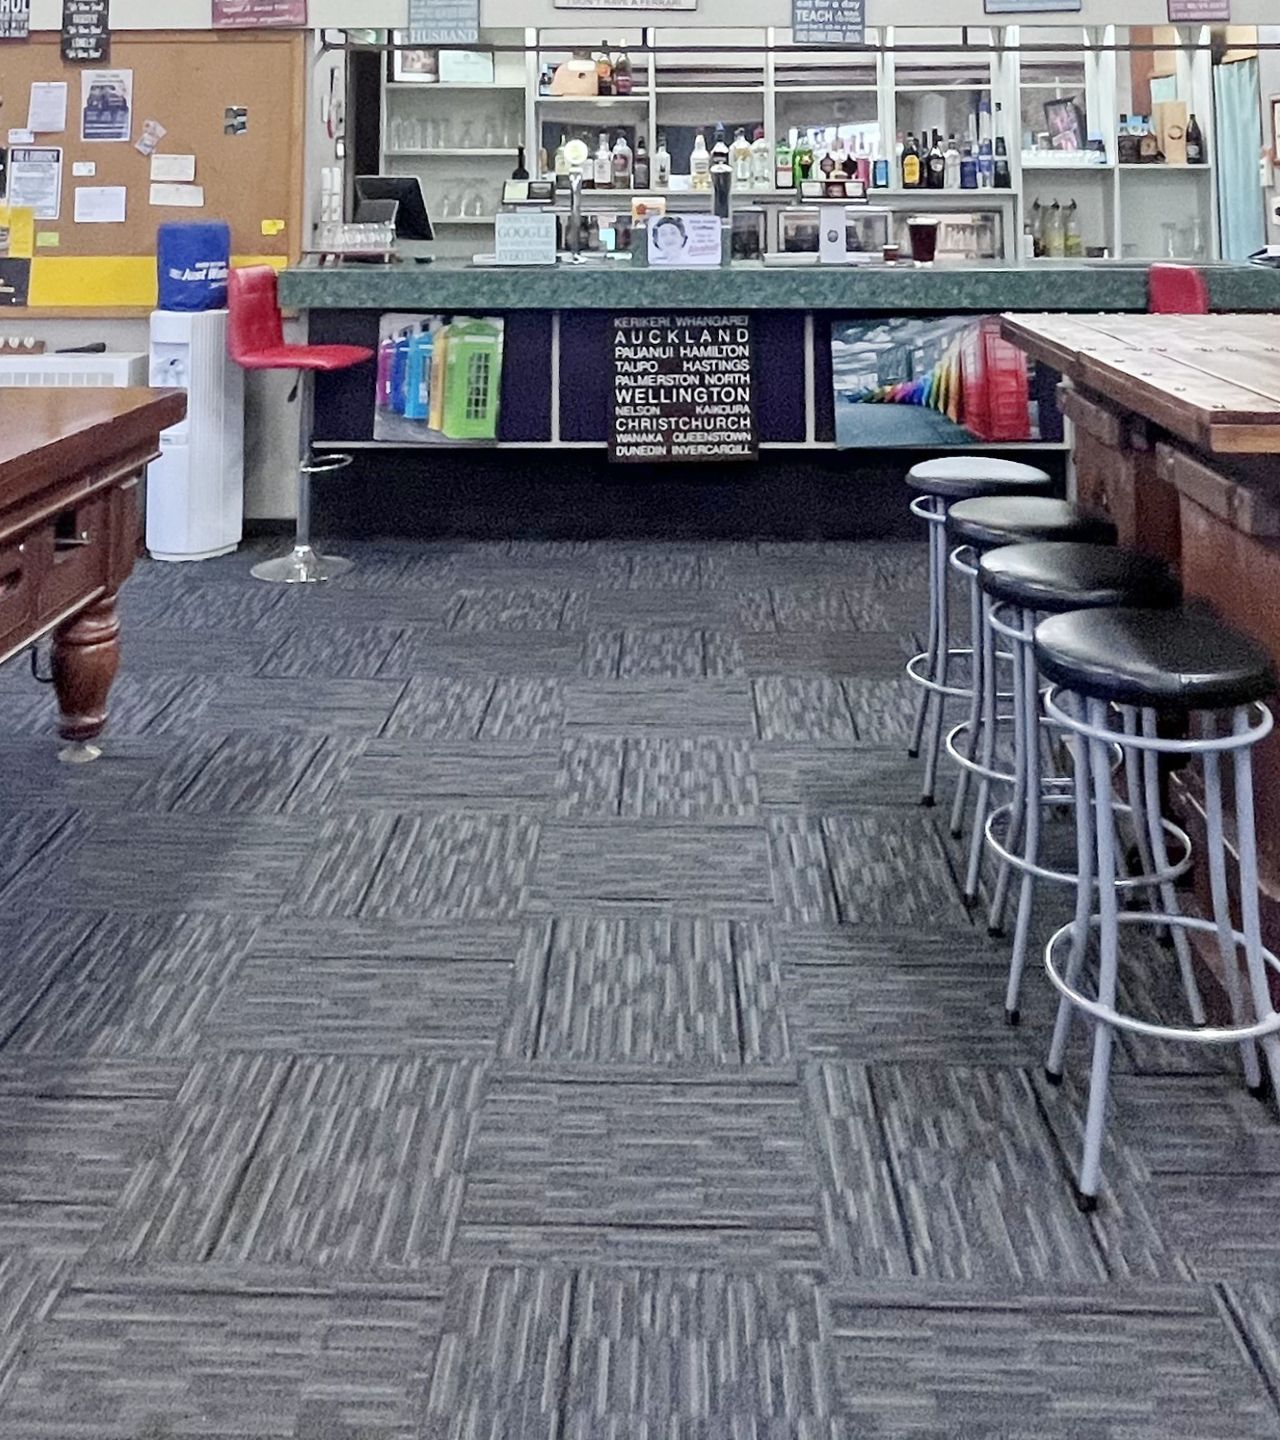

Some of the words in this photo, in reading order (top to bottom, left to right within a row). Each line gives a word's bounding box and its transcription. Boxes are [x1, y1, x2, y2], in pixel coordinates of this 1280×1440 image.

[796, 0, 812, 8] eat
[815, 0, 830, 8] for
[841, 0, 860, 10] day
[795, 10, 833, 22] TEACH
[411, 29, 478, 41] HUSBAND
[498, 226, 553, 238] GOOGLE
[182, 268, 207, 280] Just
[615, 317, 671, 328] KERIKERI
[675, 315, 749, 327] WHANGAREI
[614, 329, 749, 344] AUCKLAND
[615, 346, 673, 359] PAUANUI
[680, 345, 749, 358] HAMILTON
[614, 361, 658, 373] TAUPO
[683, 359, 750, 372] HASTINGS
[615, 374, 700, 386] PALMERSTON
[704, 373, 750, 385] NORTH
[615, 387, 750, 403] WELLINGTON
[615, 405, 660, 416] NELSON
[695, 404, 751, 415] KAIKOURA
[615, 417, 751, 431] CHRISTCHURCH
[616, 433, 663, 443] WANAKA
[672, 432, 751, 442] QUEENSTOWN
[616, 445, 666, 456] DUNEDIN
[671, 444, 752, 455] INVERCARGILL
